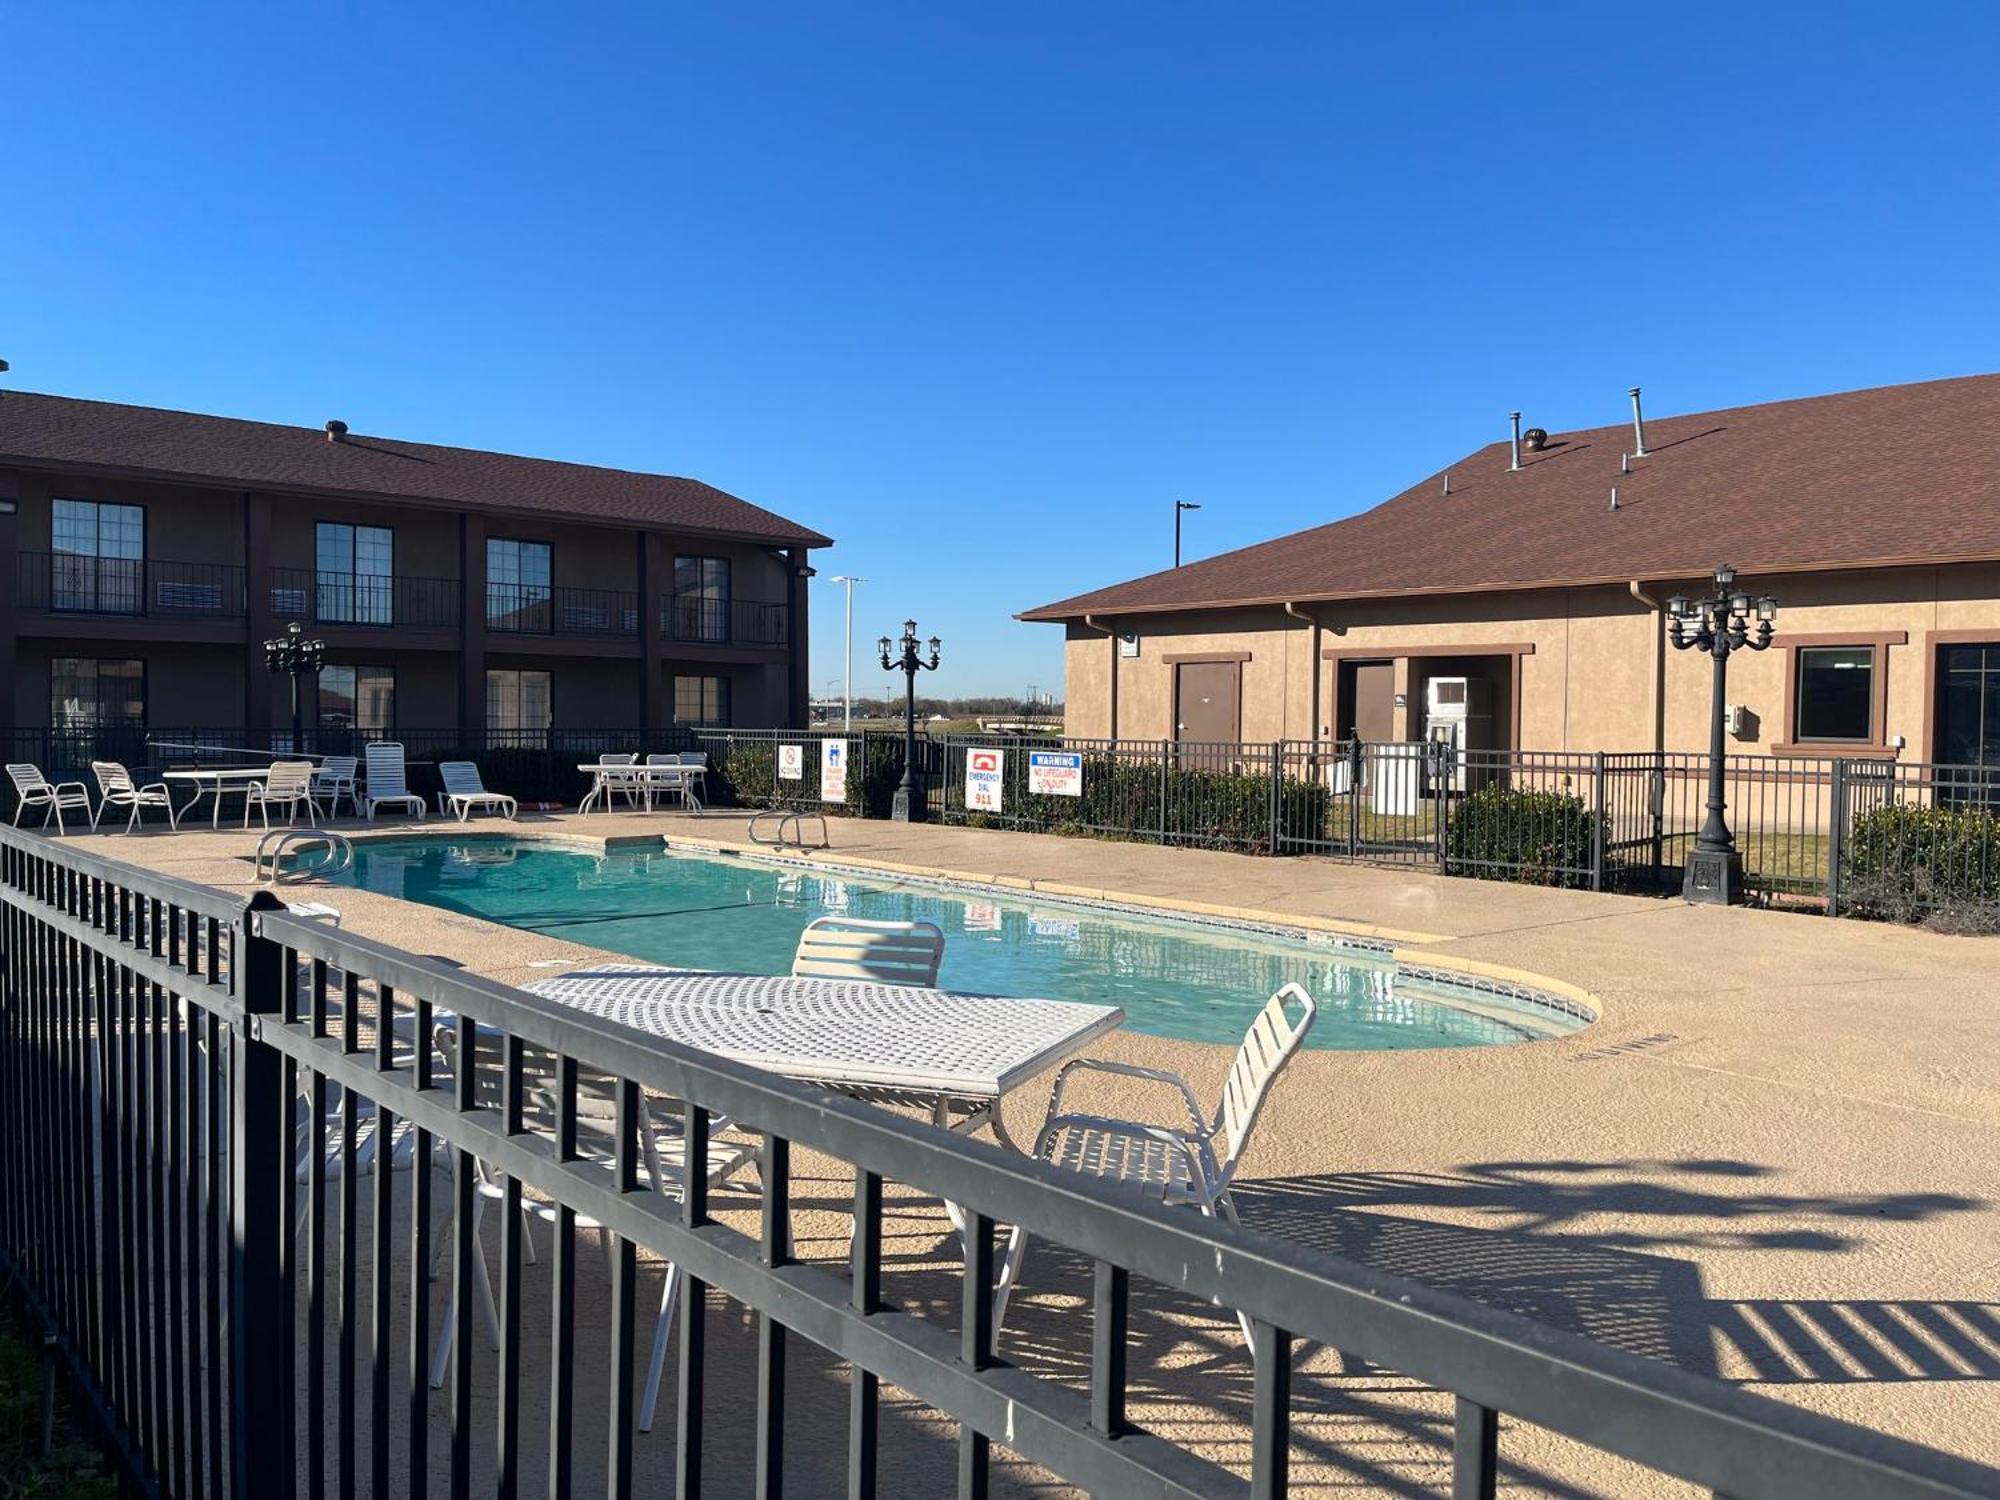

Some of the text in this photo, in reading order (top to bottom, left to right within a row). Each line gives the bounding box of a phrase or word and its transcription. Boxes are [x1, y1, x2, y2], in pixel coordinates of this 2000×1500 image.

[1037, 755, 1075, 767] WARNING
[969, 772, 1000, 782] EMERGENCY
[1034, 768, 1077, 779] NO LIFEGUARD
[975, 793, 992, 805] 911
